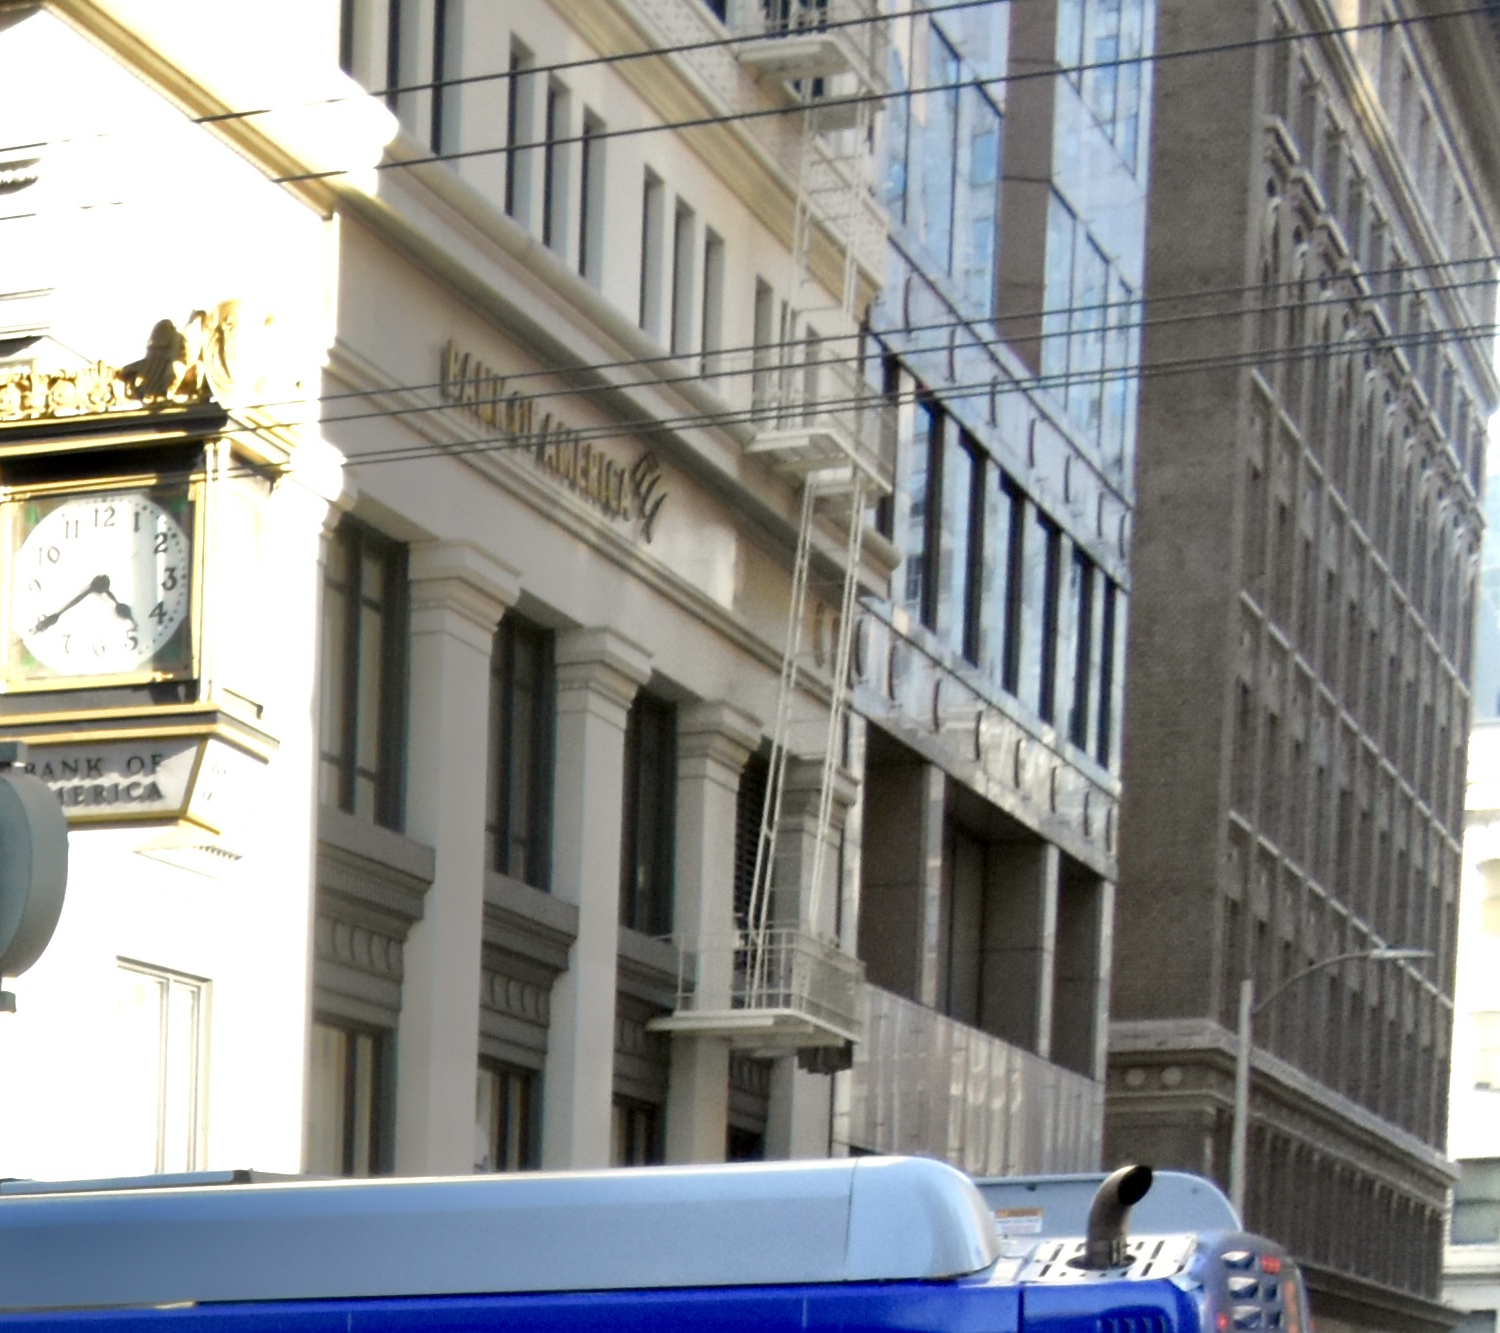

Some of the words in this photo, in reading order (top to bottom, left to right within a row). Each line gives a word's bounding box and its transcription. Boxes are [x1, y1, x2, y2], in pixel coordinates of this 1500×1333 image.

[153, 531, 168, 554] 2
[161, 566, 178, 592] 3
[148, 600, 167, 625] 4
[125, 754, 164, 774] OF
[58, 781, 166, 808] ERICA
